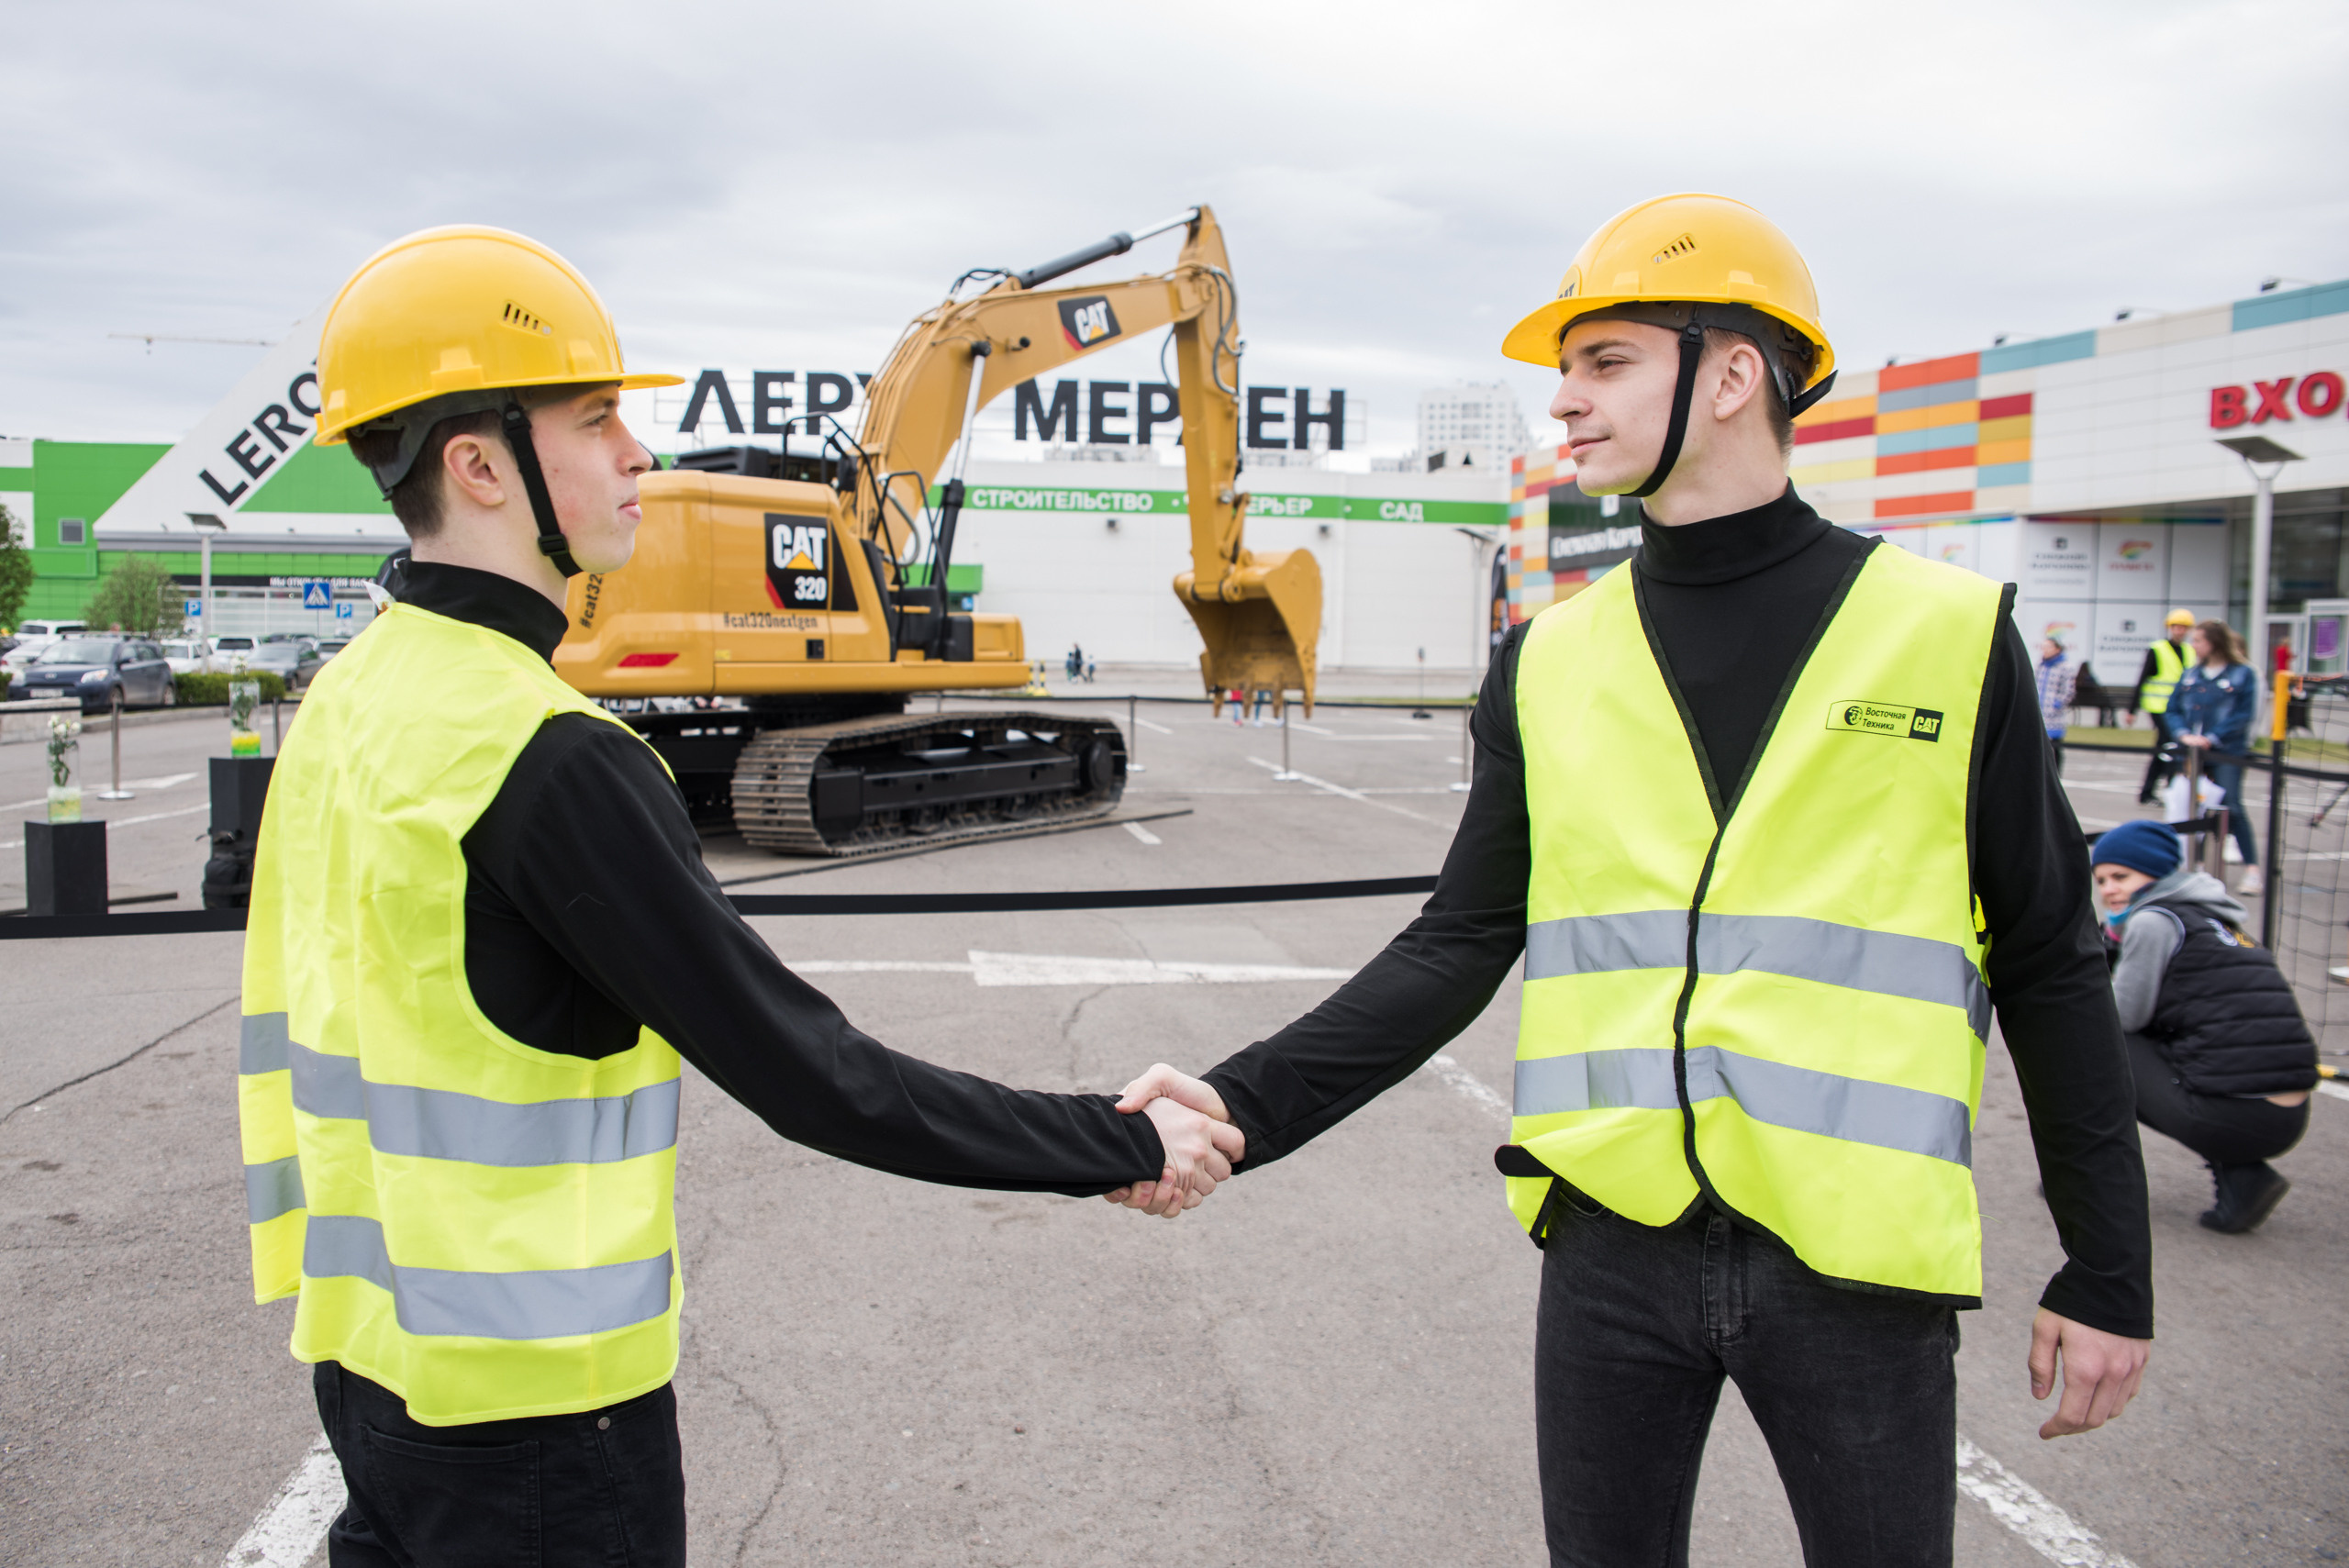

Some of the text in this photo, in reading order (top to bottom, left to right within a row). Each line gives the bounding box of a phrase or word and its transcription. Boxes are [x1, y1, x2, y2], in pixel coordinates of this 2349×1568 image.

[1074, 300, 1110, 343] CAT
[1014, 378, 1345, 451] МЕРЕН
[2210, 372, 2349, 429] ВХО
[198, 355, 322, 506] LERO
[972, 489, 1153, 511] СТРОИТЕЛЬСТВО
[1379, 502, 1424, 522] САД
[773, 524, 827, 571] CAT
[579, 573, 604, 628] #cat32
[795, 576, 827, 601] 320
[723, 612, 818, 630] #cat320nextgen
[1863, 718, 1895, 730] Техника
[1865, 707, 1907, 719] Восточная
[1912, 716, 1940, 734] CAT
